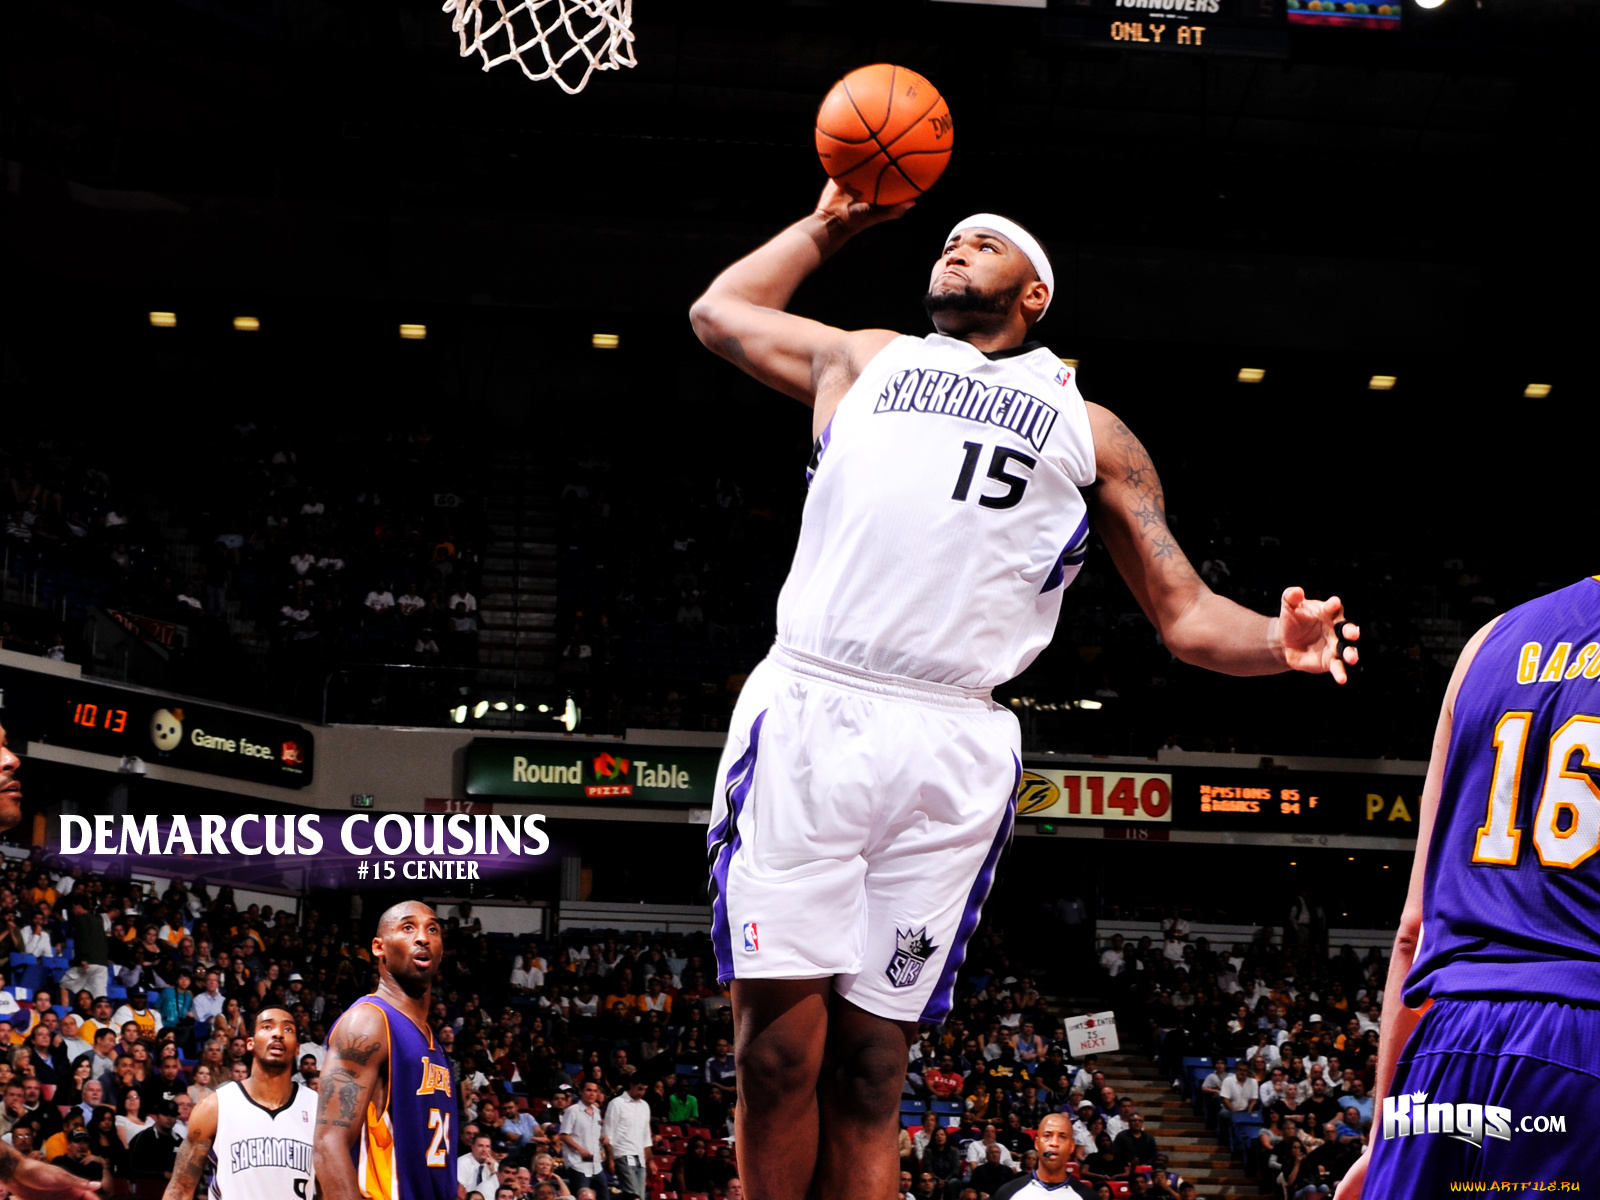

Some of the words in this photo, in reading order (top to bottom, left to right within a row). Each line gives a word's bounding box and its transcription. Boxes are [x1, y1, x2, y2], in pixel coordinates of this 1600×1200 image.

[1111, 21, 1166, 43] ONLY
[1177, 25, 1206, 45] AT
[873, 368, 1058, 453] SACRAMENTO
[951, 440, 1037, 510] 15
[1516, 641, 1600, 685] GASO
[191, 729, 236, 753] Game
[239, 738, 275, 760] face.
[513, 756, 582, 784] Round
[633, 760, 690, 789] Table
[589, 786, 630, 796] PIZZA
[1063, 775, 1171, 818] 1140
[1471, 711, 1600, 870] 16
[444, 801, 474, 814] 117
[1366, 793, 1422, 822] PA
[1125, 828, 1149, 840] 118
[1080, 1037, 1106, 1050] NEXT
[1087, 1031, 1098, 1040] IS
[231, 1136, 313, 1177] SACRAMENTO
